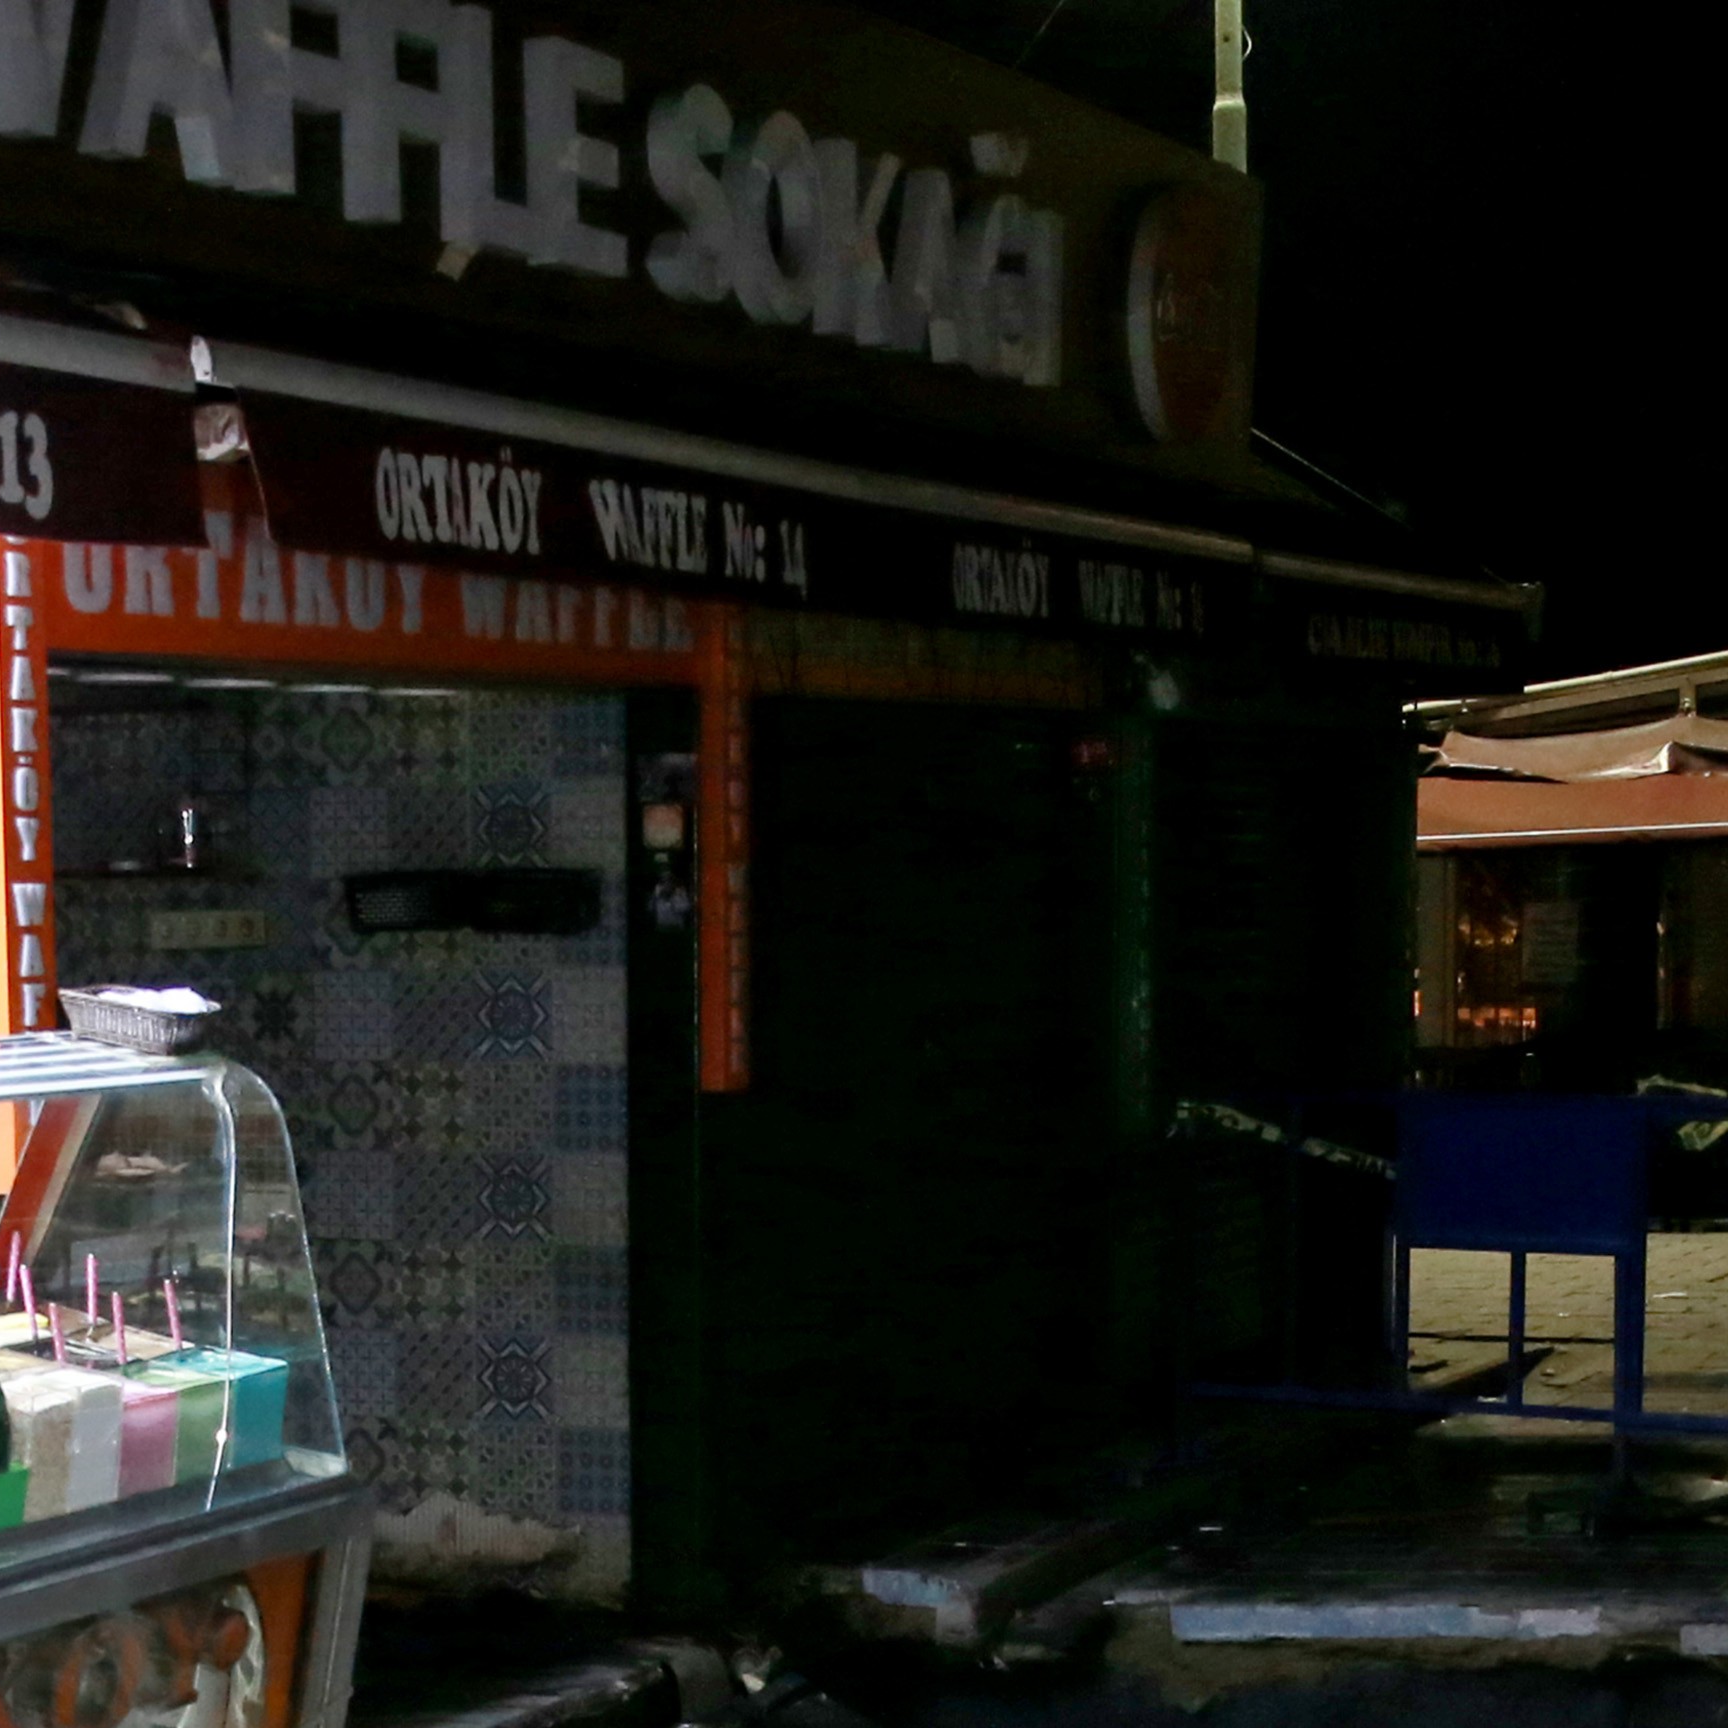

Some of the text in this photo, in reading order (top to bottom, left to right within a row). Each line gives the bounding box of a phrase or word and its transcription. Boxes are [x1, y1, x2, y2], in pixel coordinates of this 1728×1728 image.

[376, 446, 542, 556] ORTAKÖY
[588, 478, 709, 577] WAFFLE
[722, 500, 767, 585] No:
[5, 535, 41, 862] RTAKÖY
